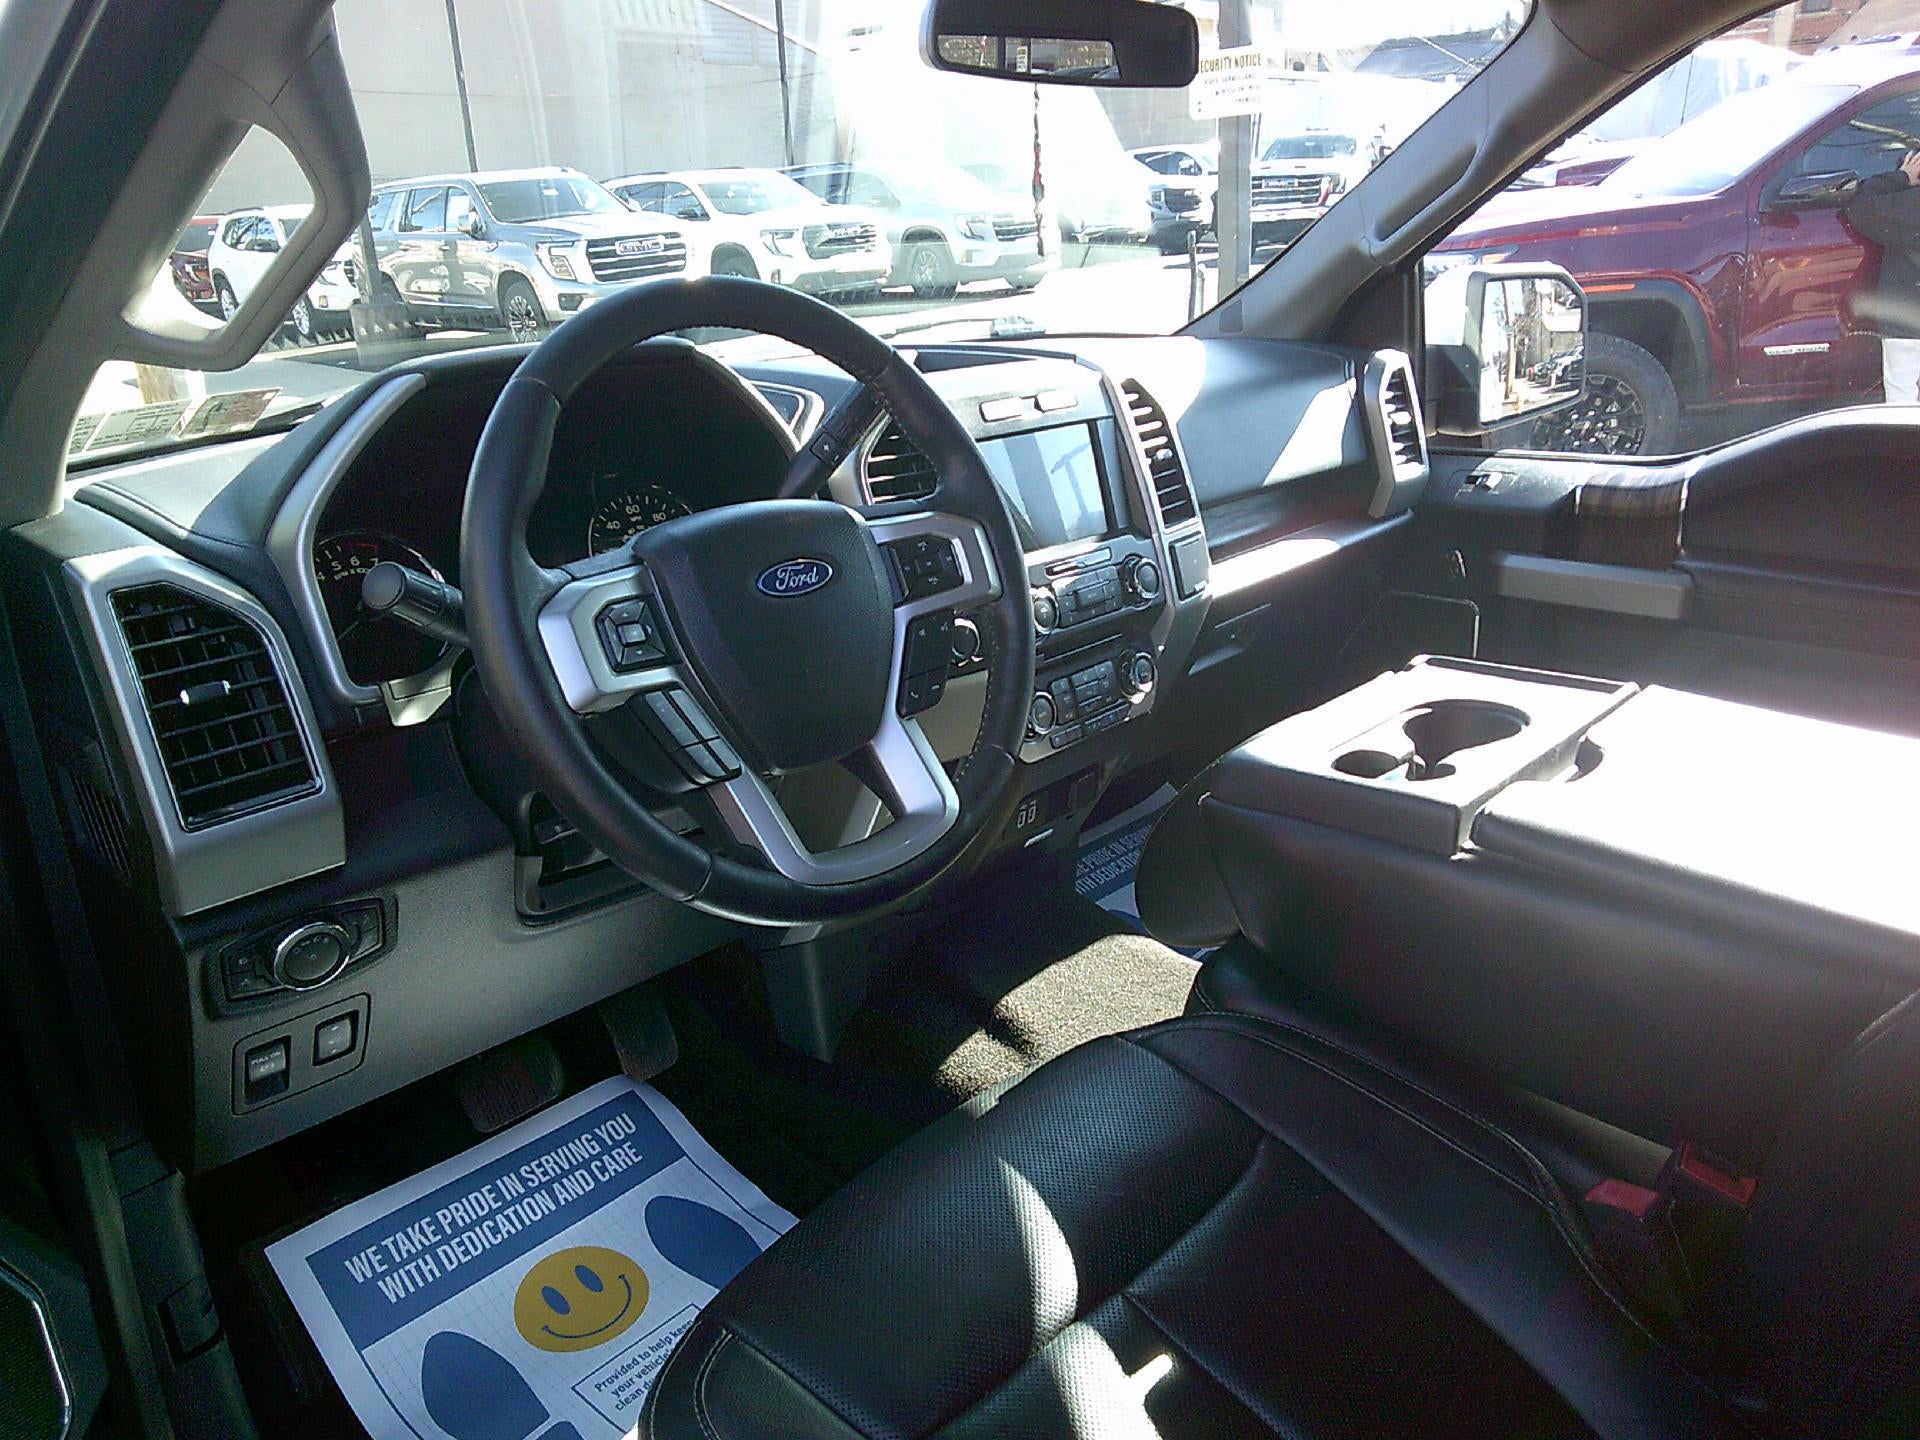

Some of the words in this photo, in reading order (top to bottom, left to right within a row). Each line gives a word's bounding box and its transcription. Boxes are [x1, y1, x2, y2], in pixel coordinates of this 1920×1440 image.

[1200, 56, 1232, 73] ECURITY
[1234, 53, 1261, 69] NOTICE
[625, 504, 640, 515] 60
[652, 511, 667, 522] 80
[606, 520, 620, 530] 40
[331, 561, 342, 571] 5
[350, 556, 360, 566] 6
[775, 564, 819, 590] Ford
[344, 1247, 389, 1284] WE
[381, 1216, 443, 1263] TAKE
[435, 1184, 502, 1235] PRIDE
[495, 1172, 525, 1201] IN
[519, 1132, 602, 1188] SERVING
[592, 1112, 637, 1155] YOU
[377, 1253, 443, 1305] WITH
[436, 1196, 557, 1272] DEDICATION
[551, 1168, 596, 1207] AND
[589, 1141, 643, 1183] CARE
[594, 1357, 640, 1392] Provided
[637, 1349, 652, 1361] to
[651, 1335, 674, 1354] help
[611, 1376, 636, 1399] your
[614, 1387, 645, 1412] clean
